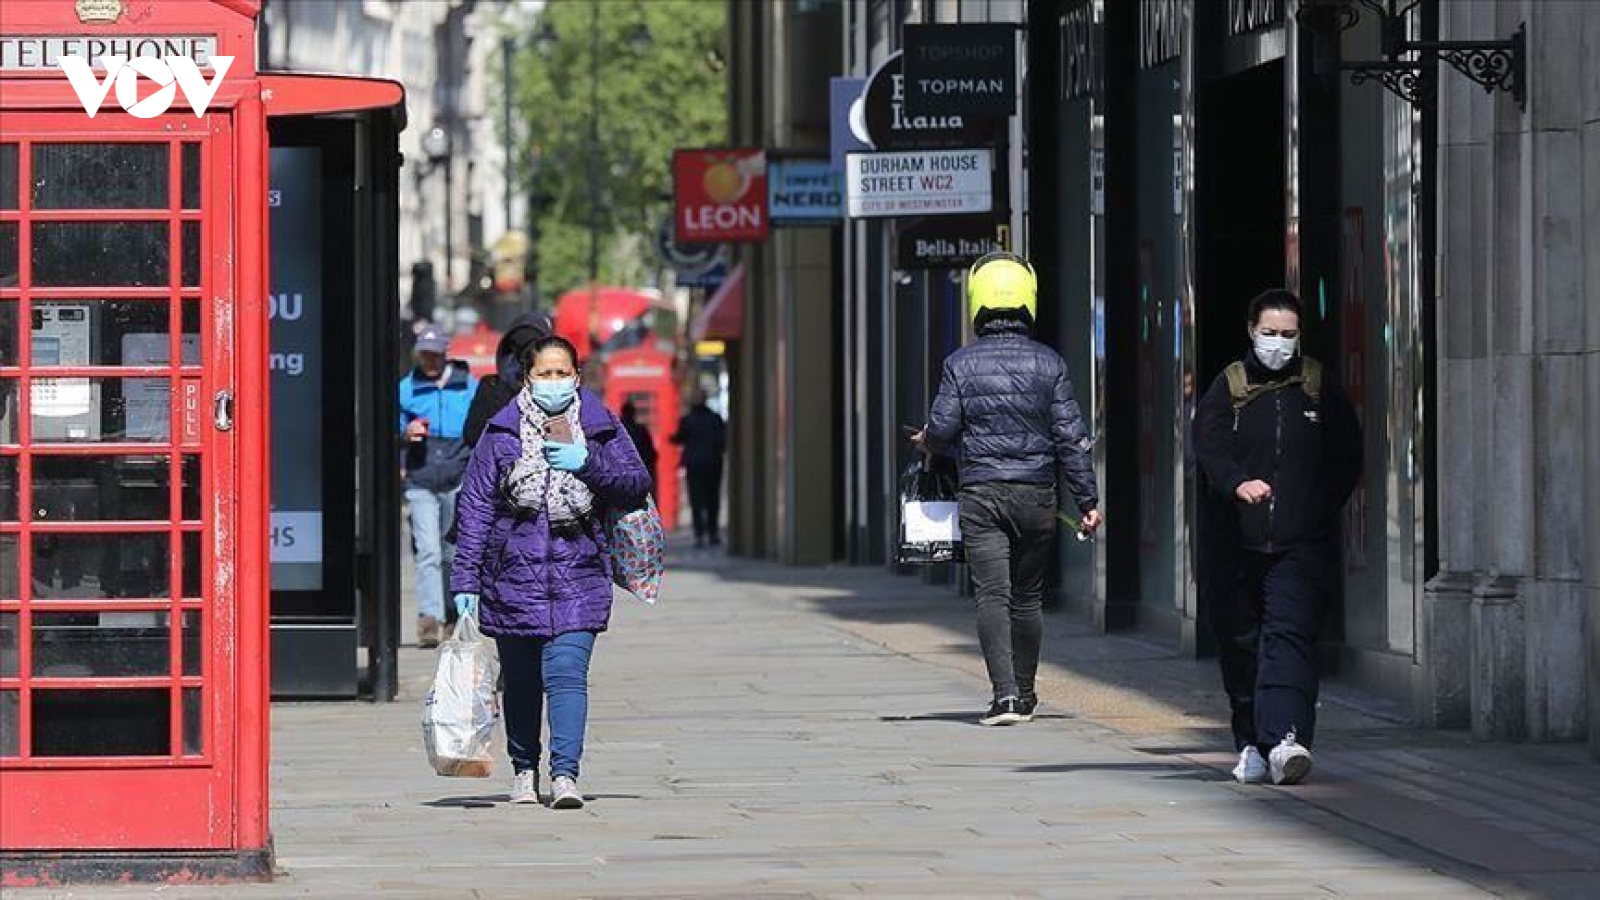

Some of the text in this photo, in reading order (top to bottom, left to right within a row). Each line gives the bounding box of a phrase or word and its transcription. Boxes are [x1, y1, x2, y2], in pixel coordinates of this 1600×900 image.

[0, 39, 208, 67] TELEPHONE
[918, 44, 1006, 60] TOPSHOP
[918, 78, 1004, 94] TOPMAN
[860, 155, 978, 175] DURHAM HOUSE
[860, 175, 955, 193] STREET WC2
[774, 191, 842, 208] NERO
[684, 205, 761, 230] LEON
[915, 238, 956, 257] Bella
[186, 384, 197, 436] PULL
